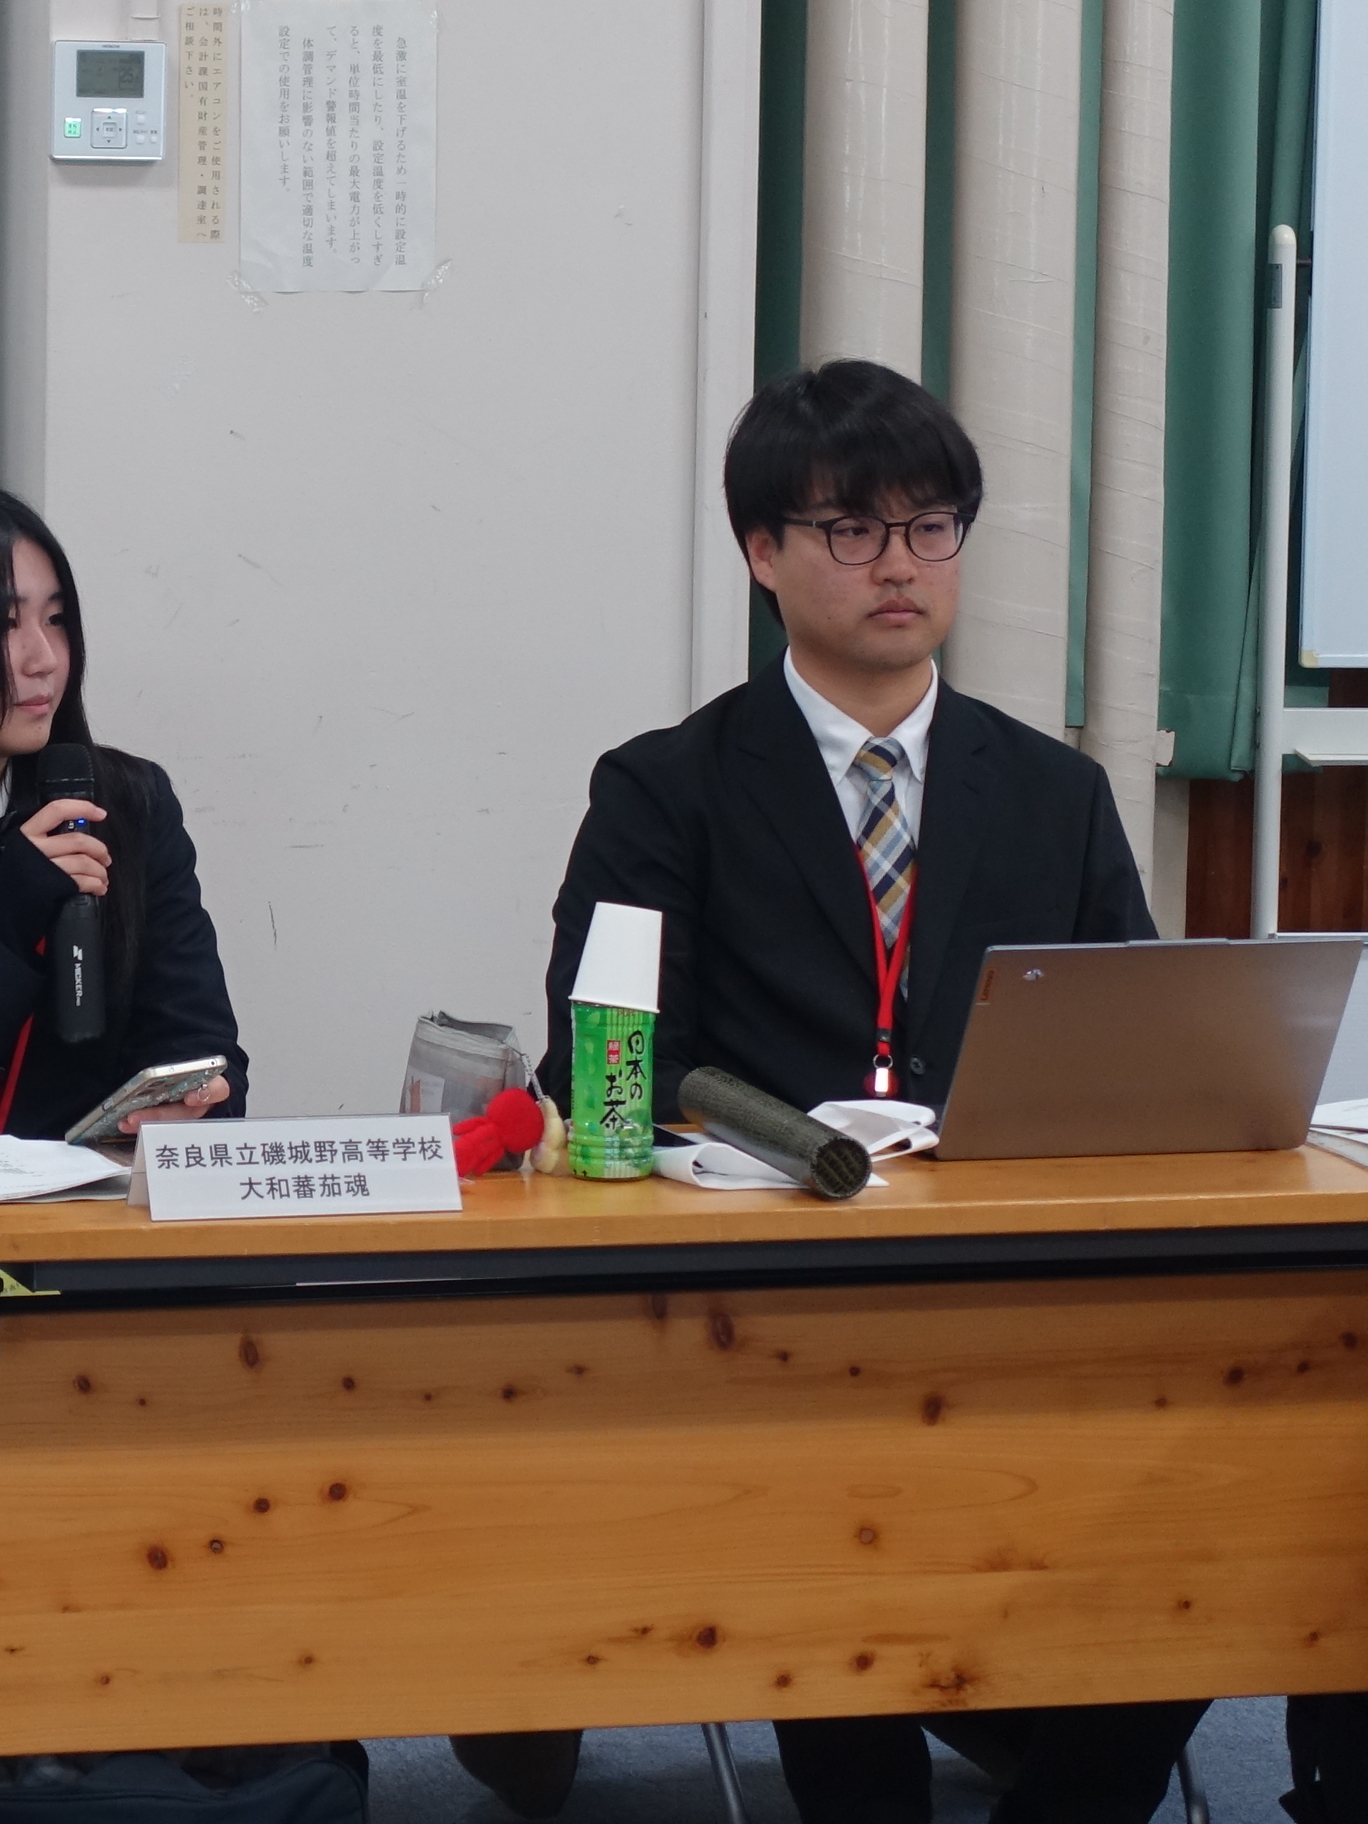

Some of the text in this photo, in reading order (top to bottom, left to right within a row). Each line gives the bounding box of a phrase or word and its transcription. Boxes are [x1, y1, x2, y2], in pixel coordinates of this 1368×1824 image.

[185, 6, 195, 98] ご相談下さい。
[210, 7, 223, 240] 時間外にエアコンをご使用される際
[278, 25, 290, 192] 設定での使用をお願いします。
[302, 37, 314, 268] 体調管理に影響のない範囲で適切な温度
[325, 25, 337, 254] て、デマンド警報値を超えてしまいます。
[348, 25, 361, 264] ると、単位時間当たりの最大電力が上がっ
[372, 24, 384, 267] 度を最低にしたり、設定温度を低くしすぎ
[394, 36, 407, 266] 急激に室温を下げるため一時的に設定温
[600, 1069, 629, 1130] お茶
[608, 1041, 620, 1064] 緑茶
[626, 1030, 647, 1100] 日本の
[155, 1136, 444, 1169] 奈良県立磯城野高等学校
[239, 1173, 370, 1200] 大和蕃茄魂
